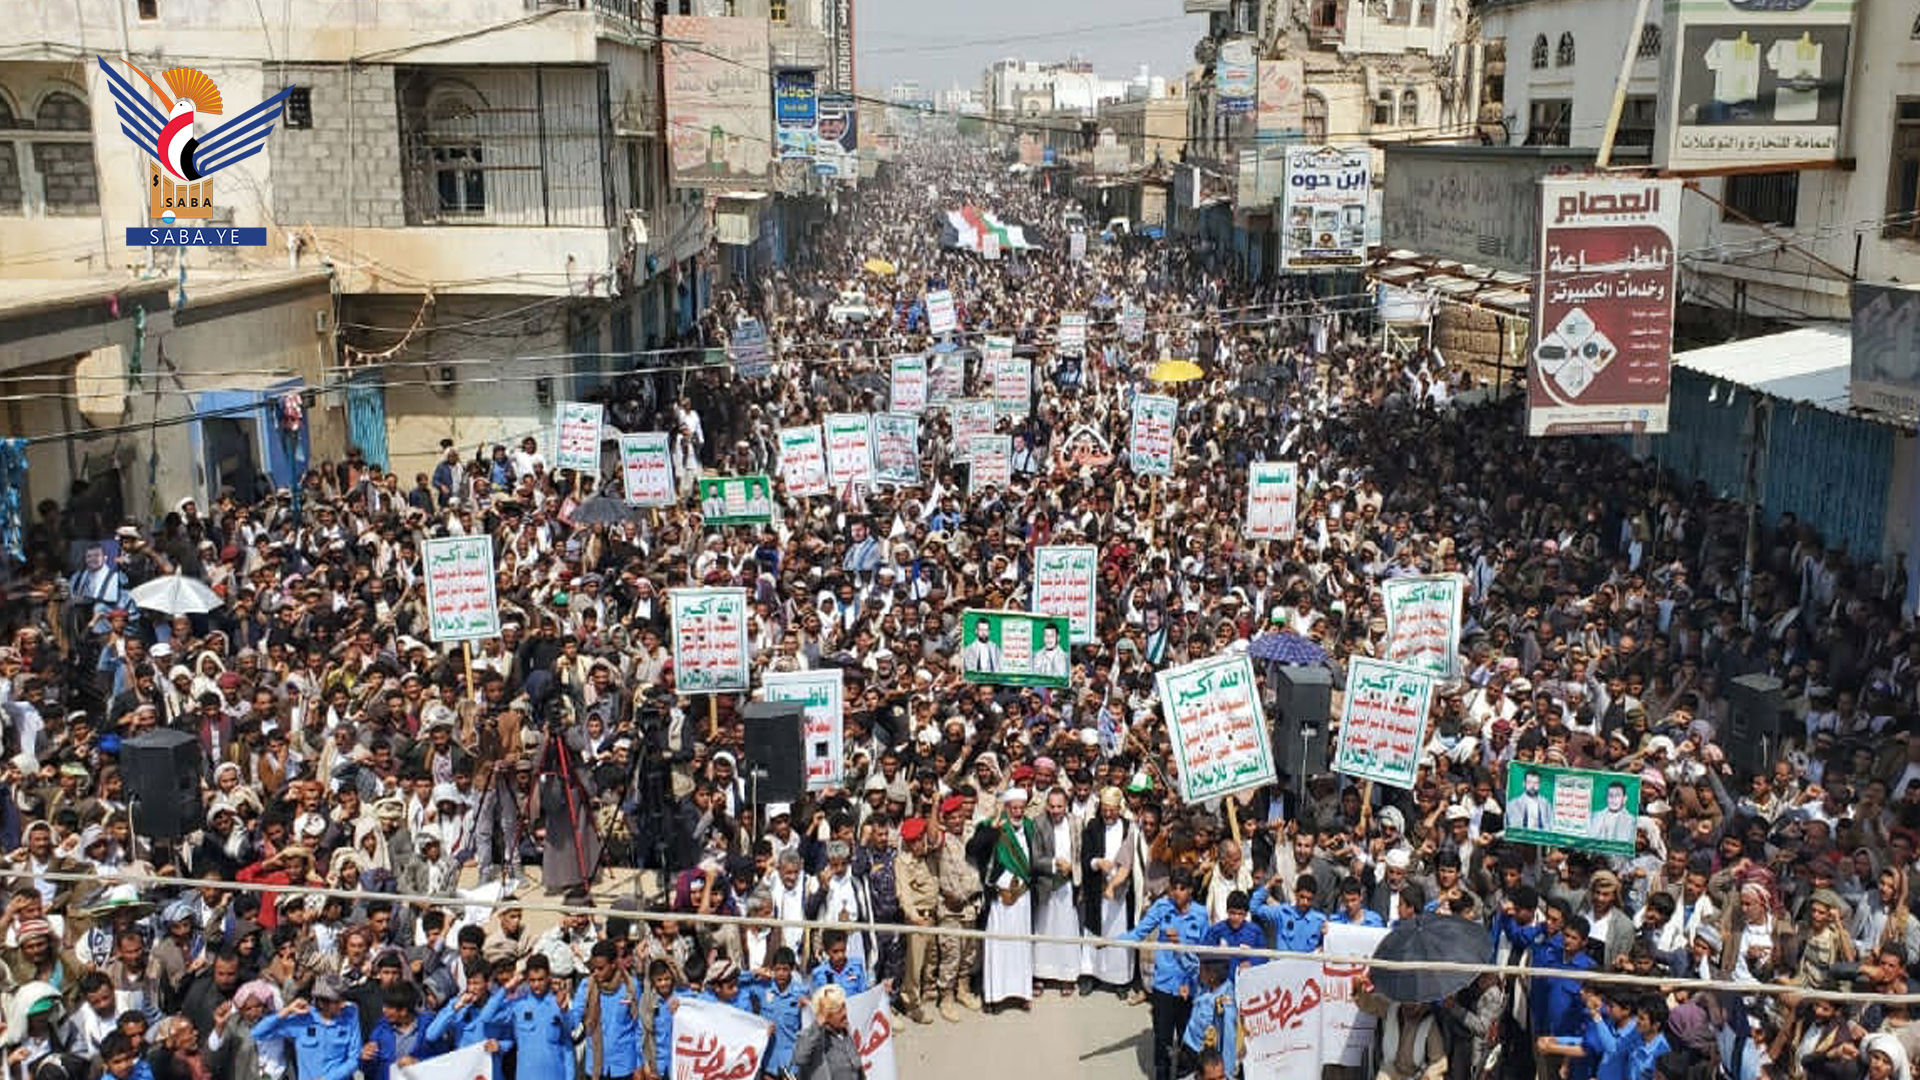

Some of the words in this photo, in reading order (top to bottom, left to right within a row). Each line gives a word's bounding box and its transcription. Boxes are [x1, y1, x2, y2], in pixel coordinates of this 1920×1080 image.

[1336, 169, 1367, 190] ابن
[1554, 187, 1660, 223] العصام
[1549, 245, 1669, 273] للطباعة
[1549, 279, 1613, 303] الكمبيوتر
[1616, 278, 1665, 300] وخدمات
[1219, 667, 1247, 688] الله
[1398, 682, 1426, 697] الله
